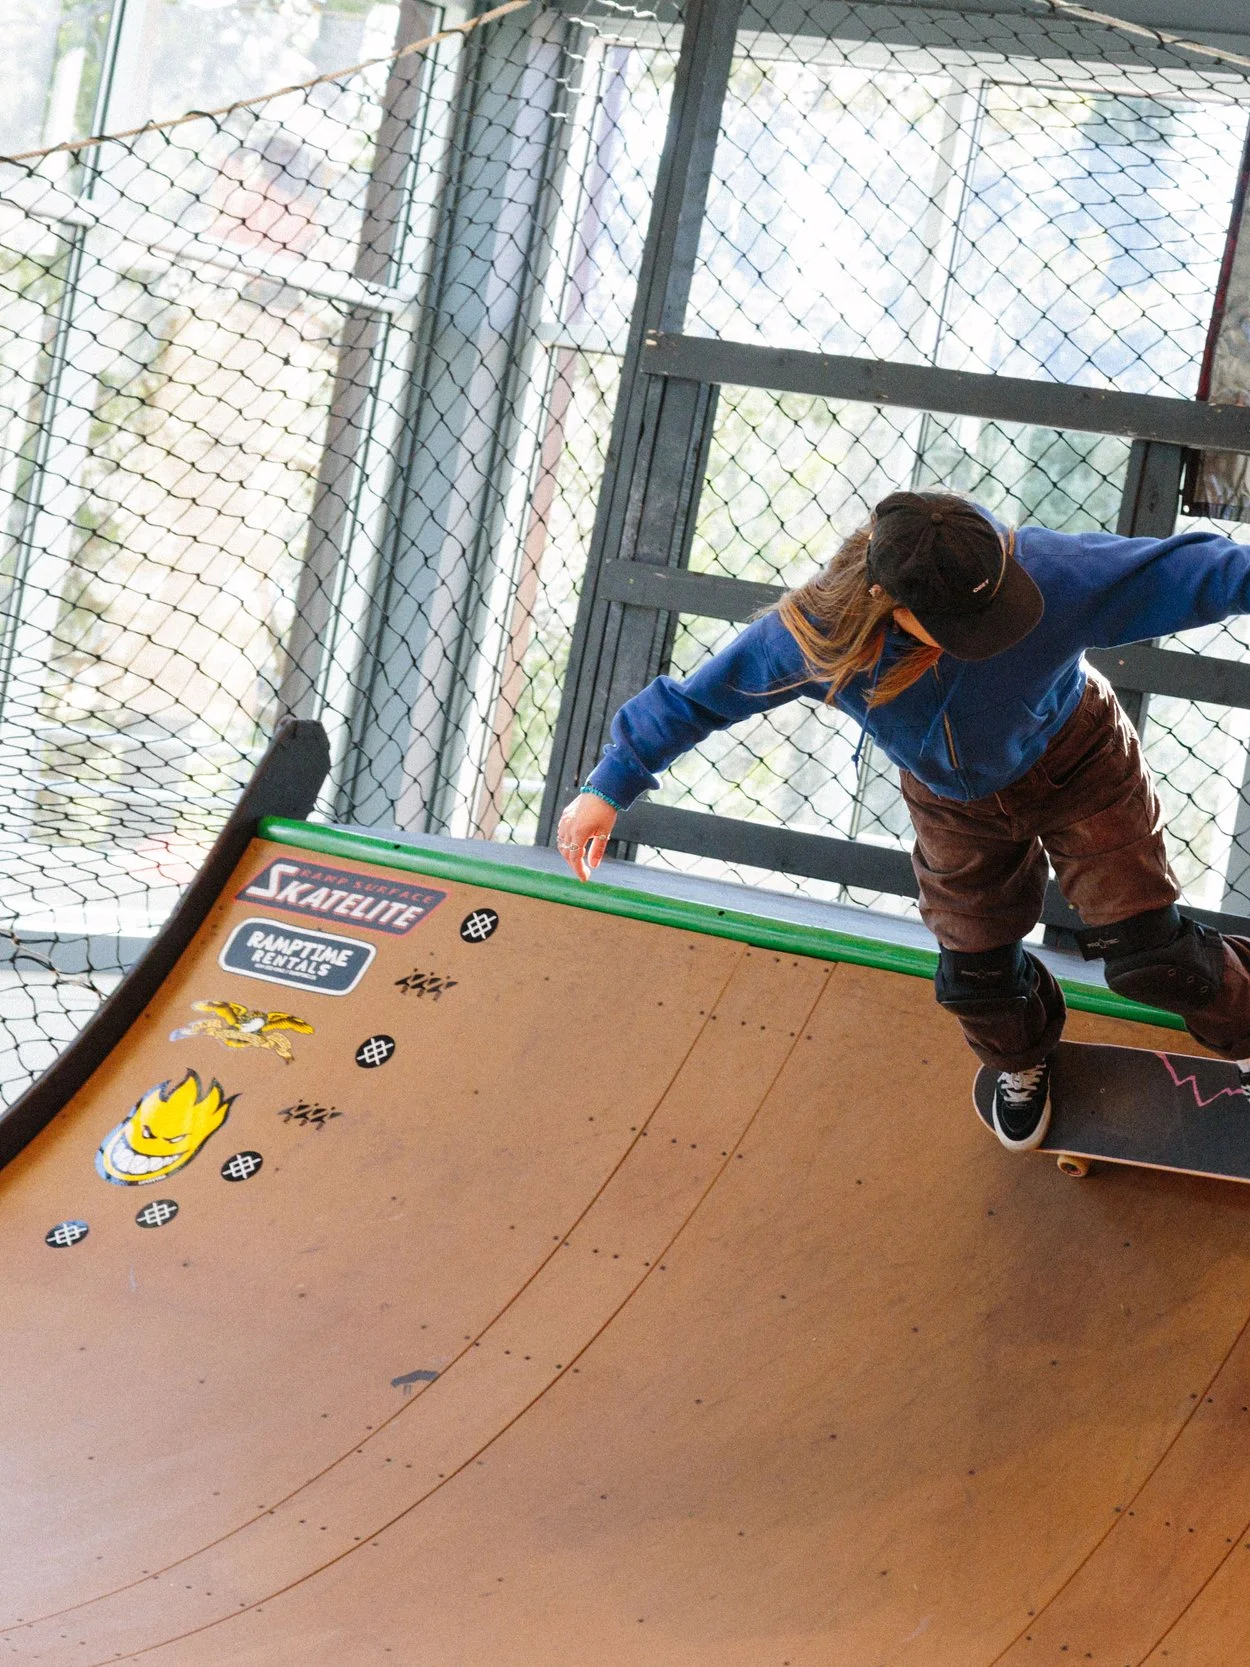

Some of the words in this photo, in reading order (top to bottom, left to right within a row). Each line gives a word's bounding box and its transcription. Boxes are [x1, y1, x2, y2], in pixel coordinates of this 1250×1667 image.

[245, 863, 425, 930] SKATELITE
[299, 869, 349, 885] RAMP
[353, 880, 436, 904] SURFACE
[246, 930, 354, 967] RAMPTIME
[251, 949, 332, 977] RENTALS
